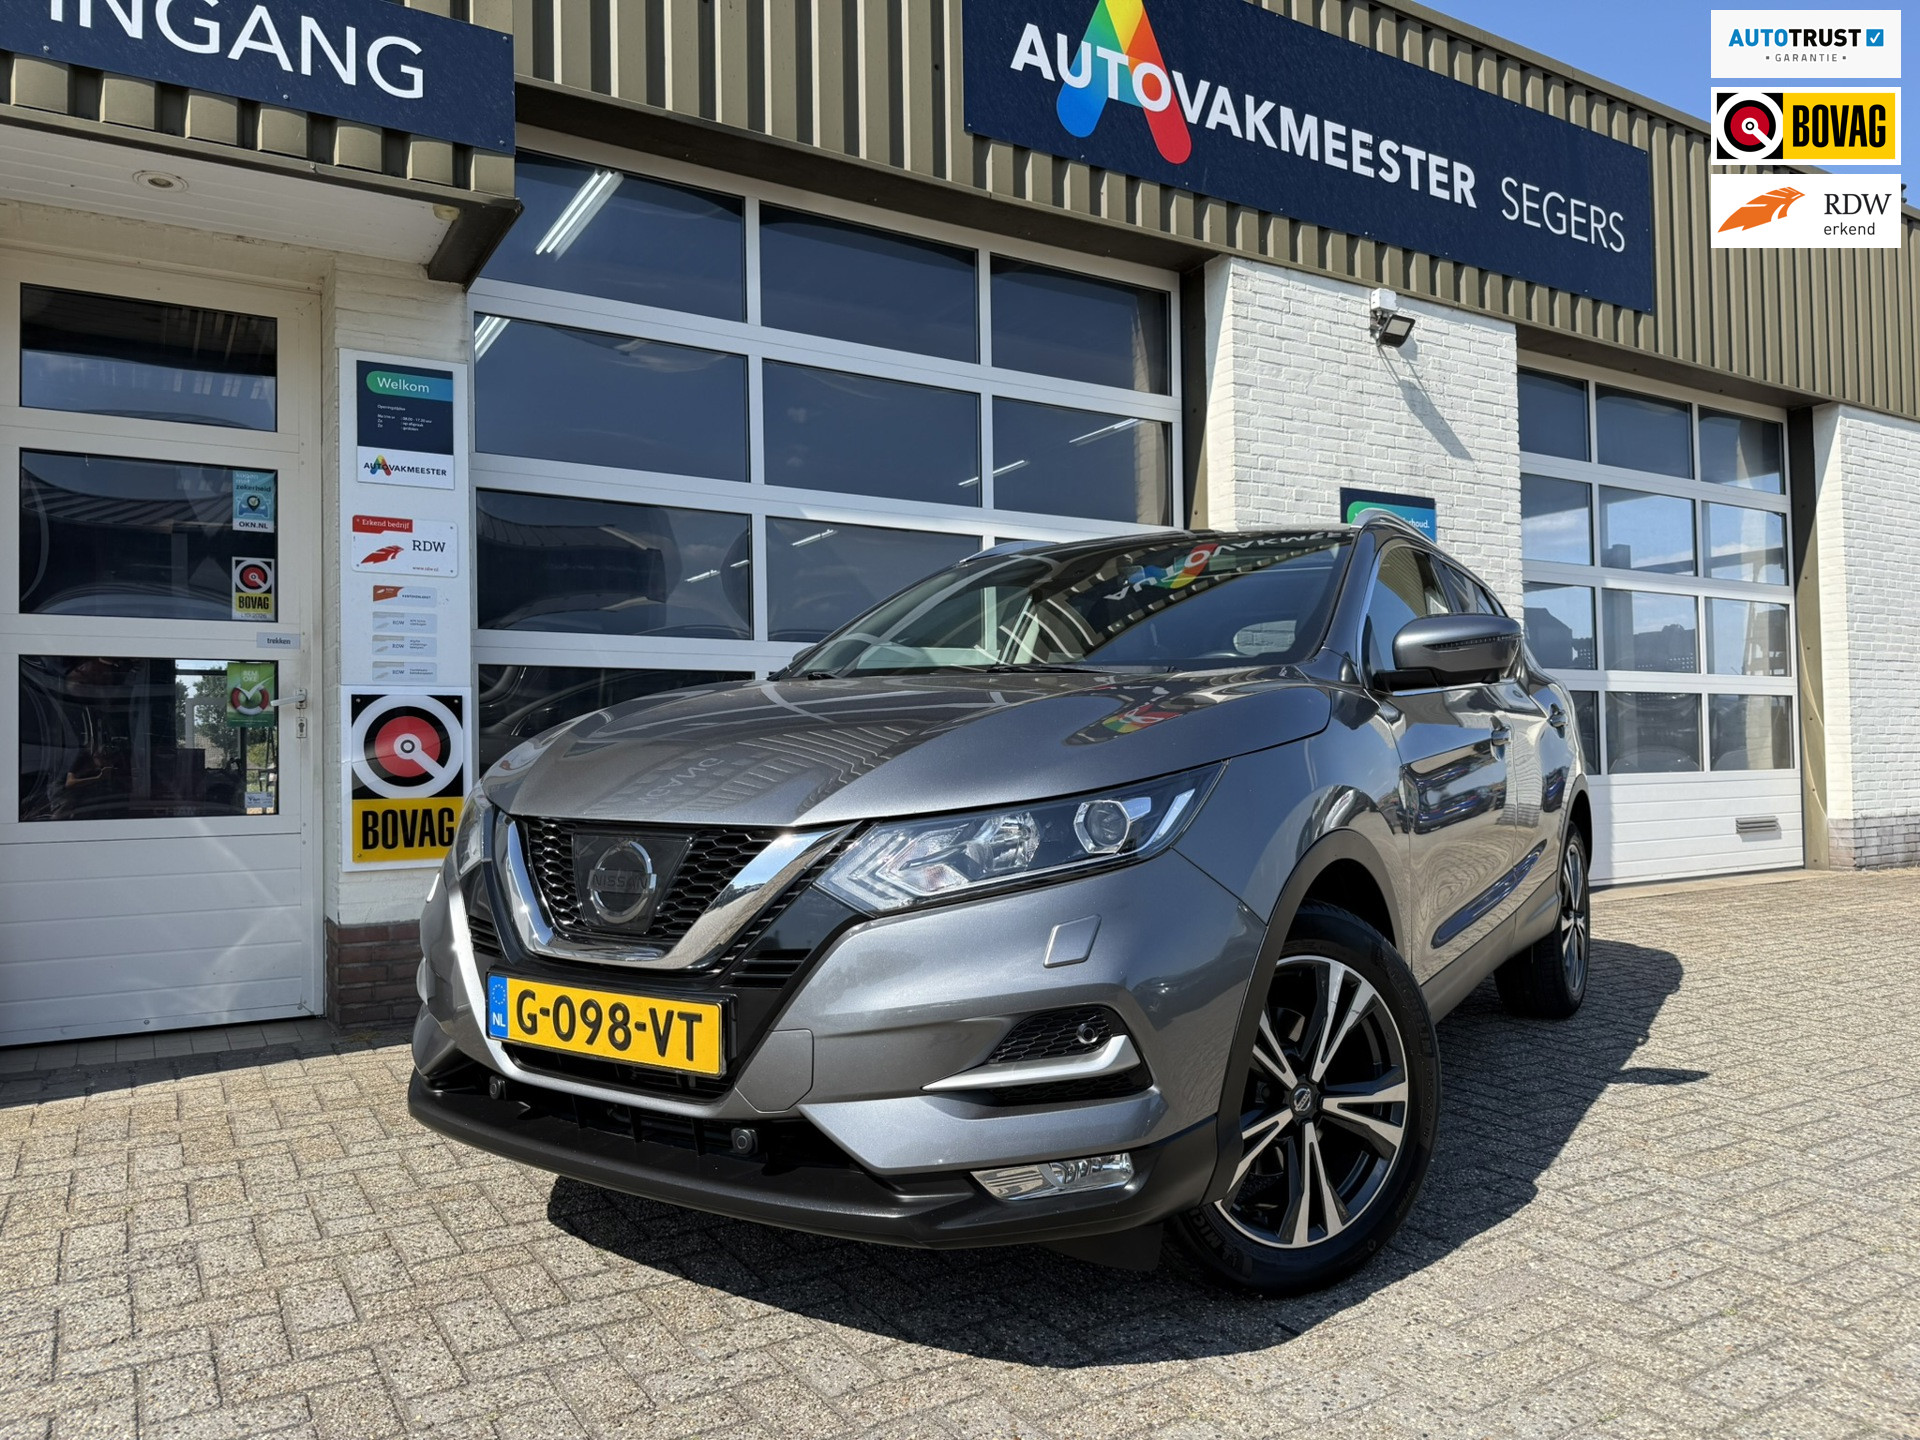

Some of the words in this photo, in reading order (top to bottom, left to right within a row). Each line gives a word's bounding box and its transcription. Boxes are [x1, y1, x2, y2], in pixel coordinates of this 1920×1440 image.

[1010, 22, 1477, 209] AUTOVAKMEESTER
[1501, 176, 1625, 253] SEGERS
[377, 376, 430, 393] Welkom
[363, 462, 447, 476] AUTOVAKMEESTER
[238, 520, 269, 529] OKN.NL
[362, 519, 387, 527] Erkend
[387, 521, 410, 530] bedrijf
[412, 539, 446, 553] RDW
[238, 595, 270, 610] BOVAG
[362, 807, 455, 850] BOVAG
[592, 873, 648, 890] NISSAN
[492, 1013, 506, 1028] NL
[516, 988, 703, 1062] G-098-VT
